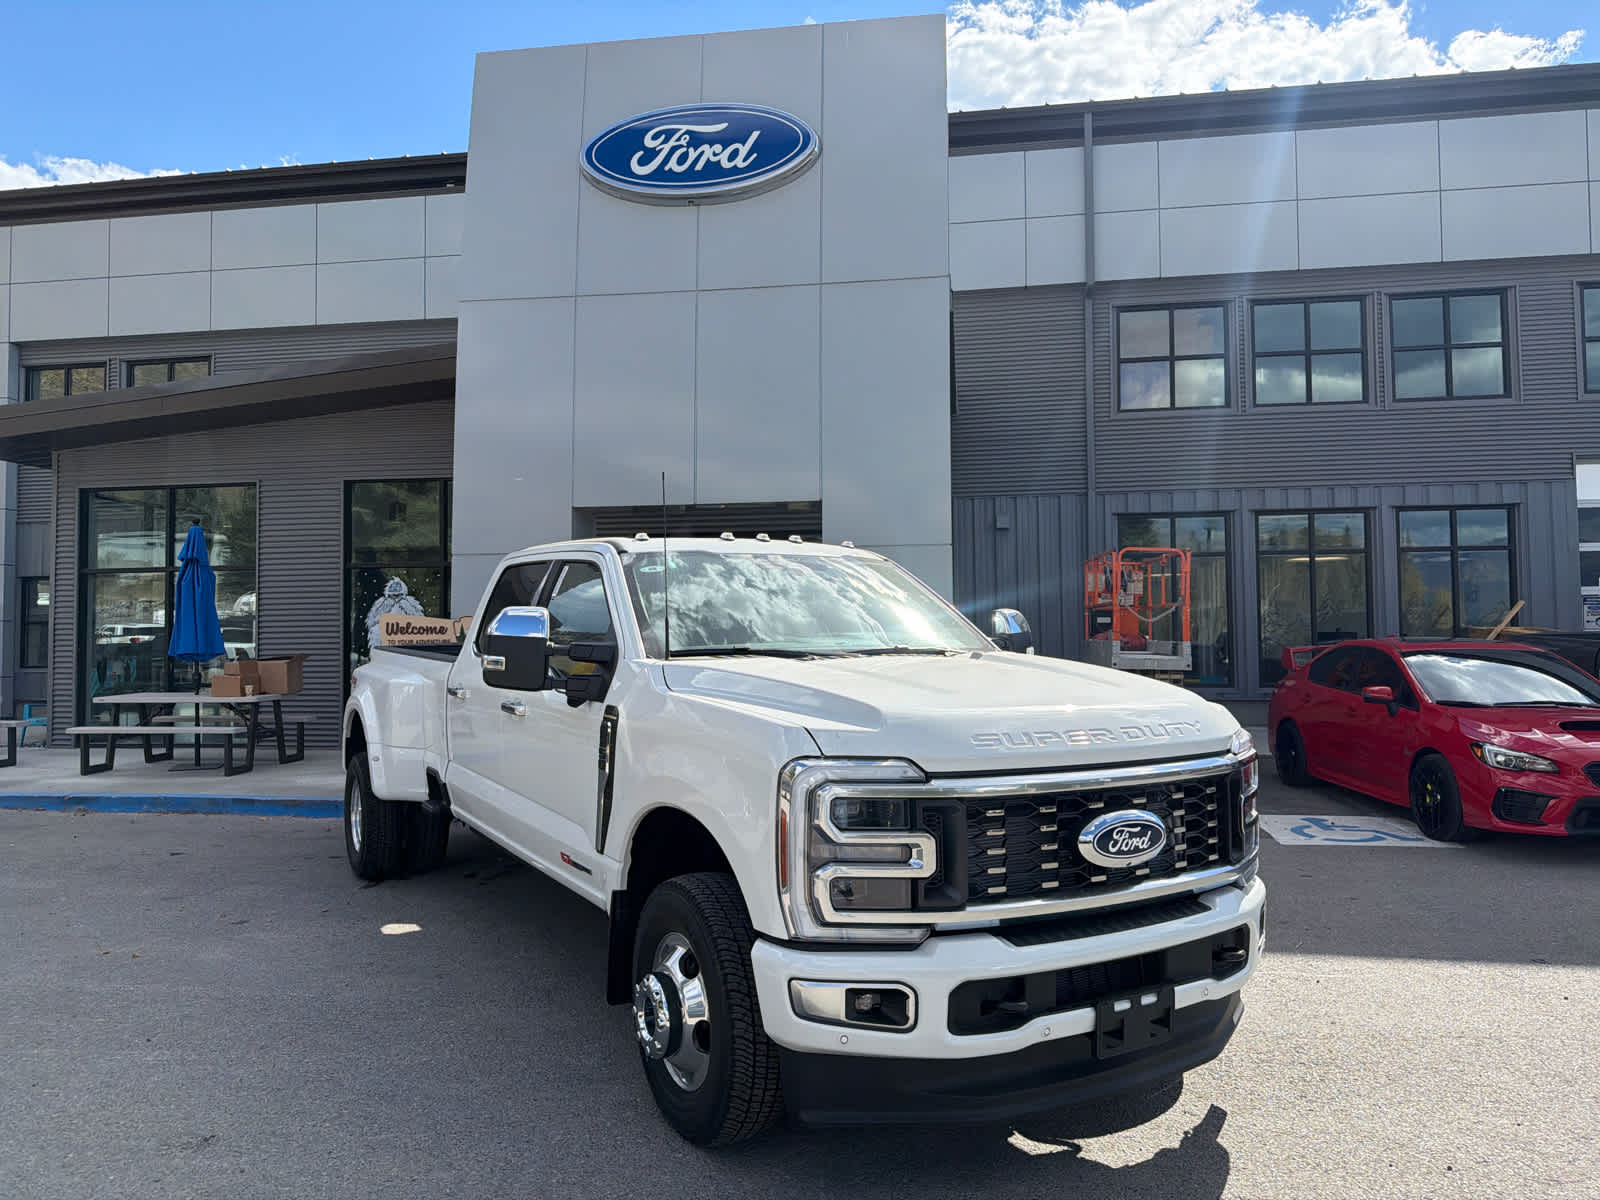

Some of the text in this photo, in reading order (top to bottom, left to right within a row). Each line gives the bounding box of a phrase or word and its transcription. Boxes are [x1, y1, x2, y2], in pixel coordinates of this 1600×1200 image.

[630, 122, 760, 175] Ford
[385, 621, 449, 637] Welcome
[970, 720, 1201, 749] SUPER DUTY
[1108, 826, 1152, 853] Ford
